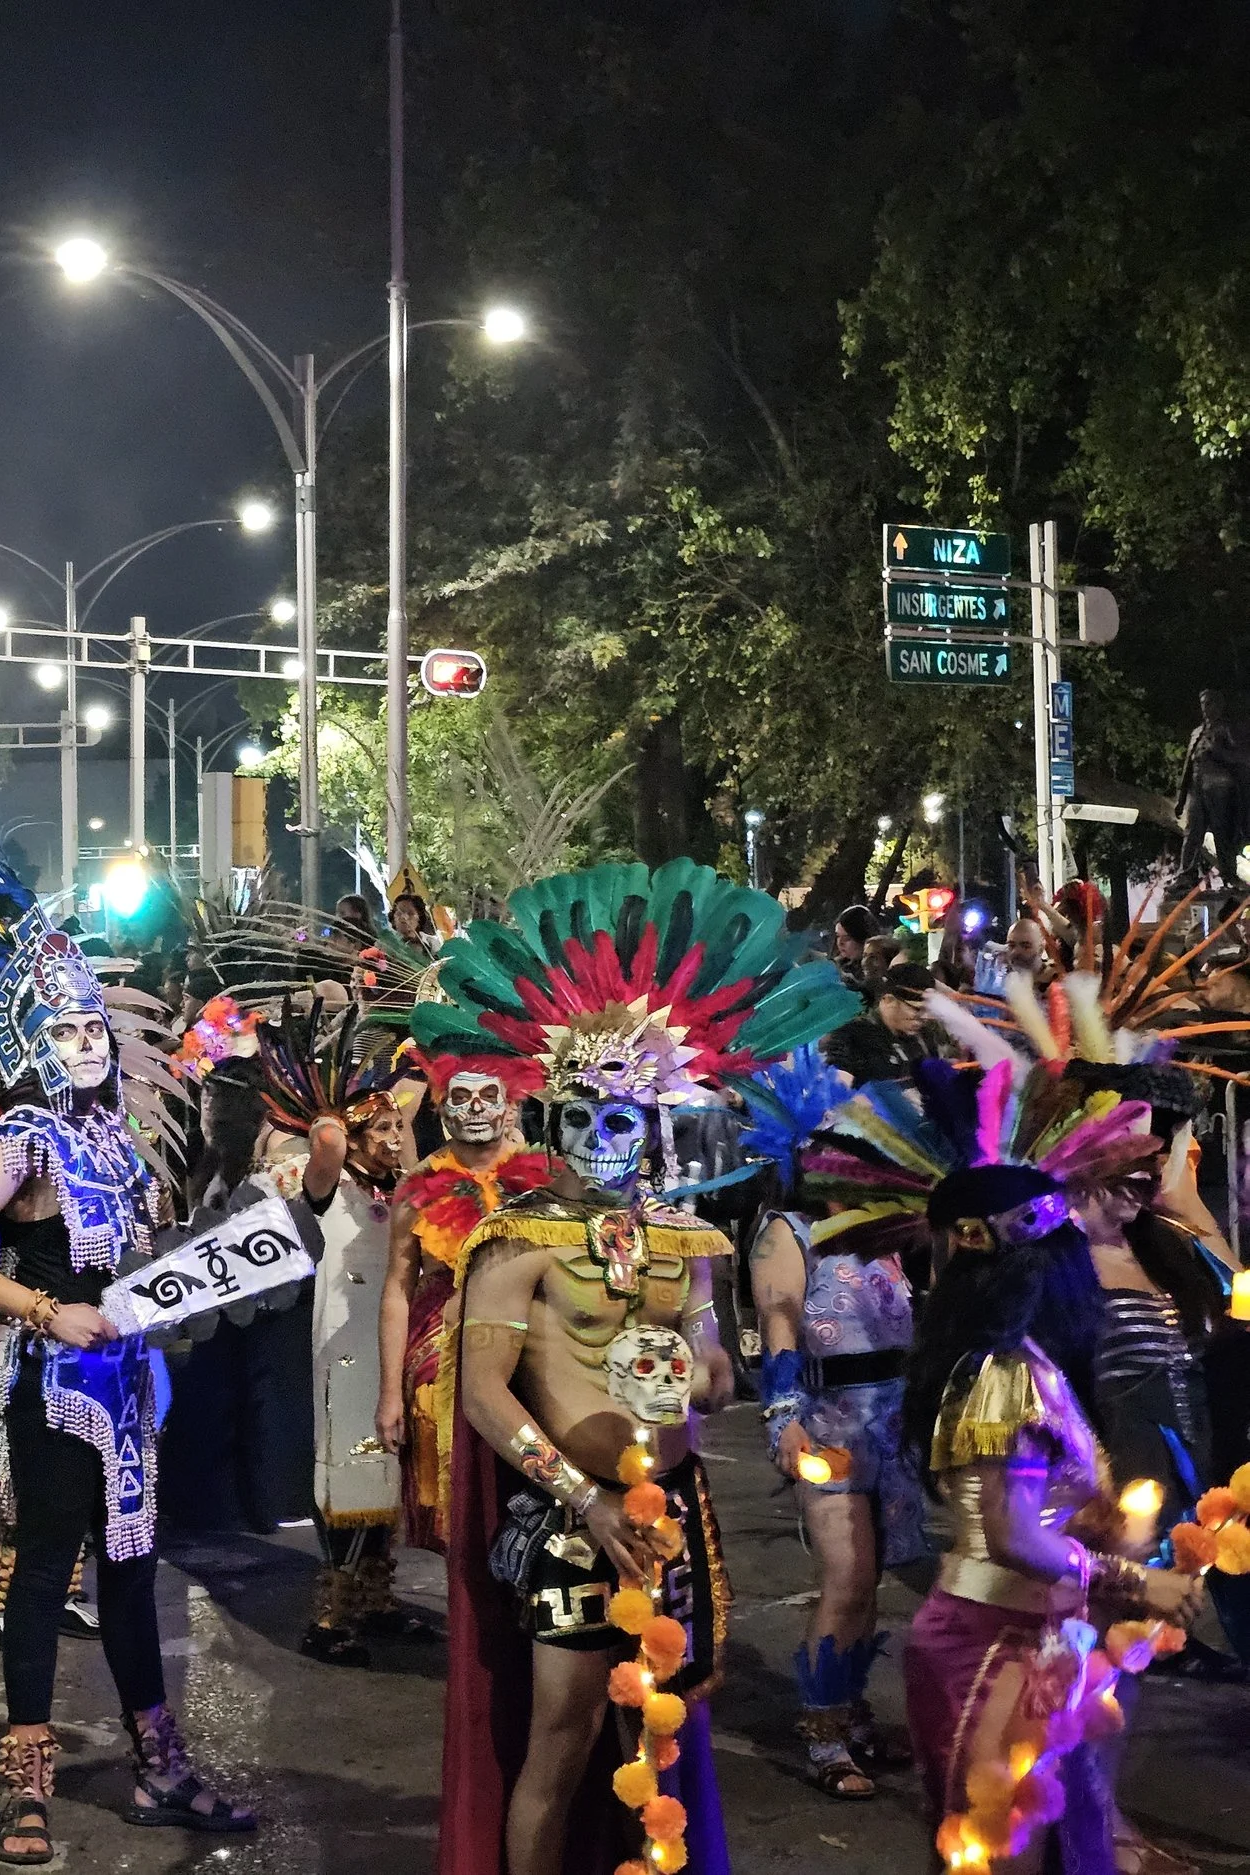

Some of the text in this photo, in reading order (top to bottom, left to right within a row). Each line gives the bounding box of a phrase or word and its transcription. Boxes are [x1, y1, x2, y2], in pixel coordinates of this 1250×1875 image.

[933, 538, 980, 565] NIZA
[896, 592, 987, 620] INSURGENTES
[900, 649, 989, 676] SAN COSME
